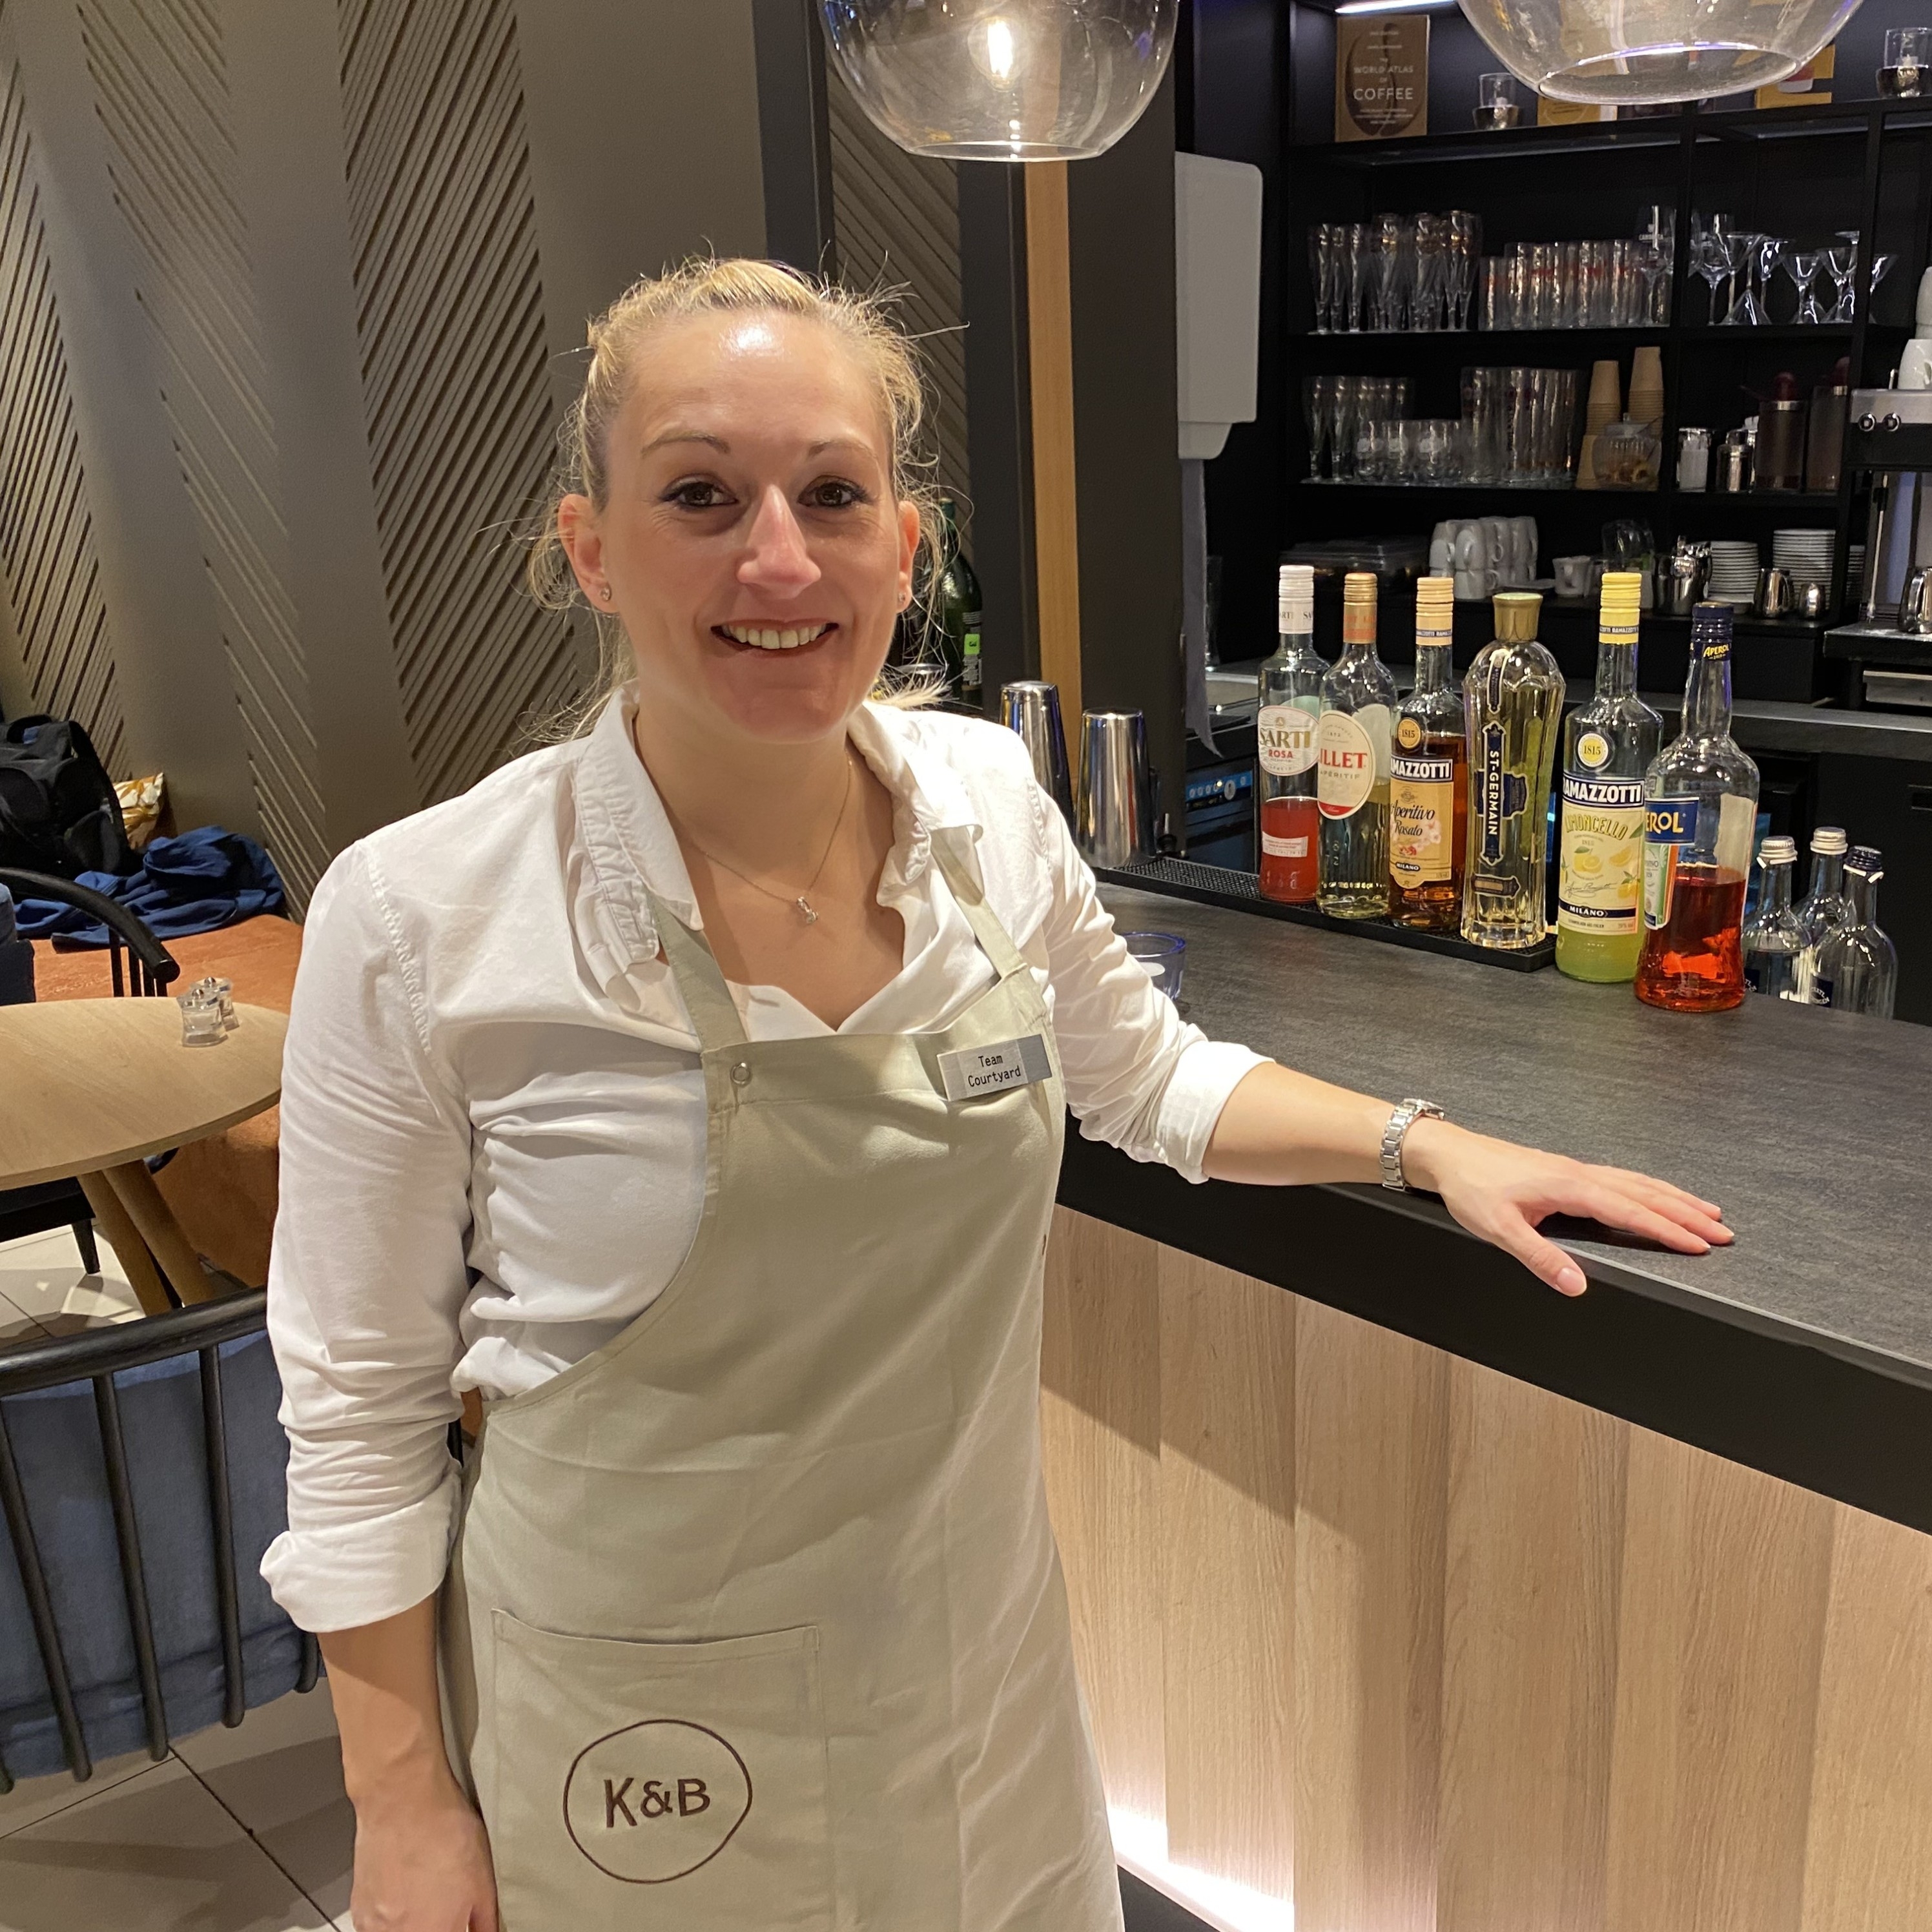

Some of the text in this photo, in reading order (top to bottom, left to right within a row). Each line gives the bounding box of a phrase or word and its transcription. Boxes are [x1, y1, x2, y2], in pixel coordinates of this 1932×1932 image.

[1353, 87, 1413, 101] COFFEE
[1703, 644, 1729, 658] APEROL
[1259, 727, 1311, 748] SARTI
[1402, 728, 1415, 738] 1815
[1268, 749, 1293, 759] ROSA
[1583, 745, 1601, 755] 1815
[1488, 750, 1499, 836] ST-GERMAIN
[1391, 799, 1435, 822] Aperitivo
[1395, 819, 1423, 836] Rosato
[1396, 862, 1419, 870] MILANO
[1569, 905, 1605, 917] MILANO
[978, 1054, 1003, 1067] Team
[967, 1065, 1022, 1087] Courtyard
[603, 1777, 711, 1829] K&B
